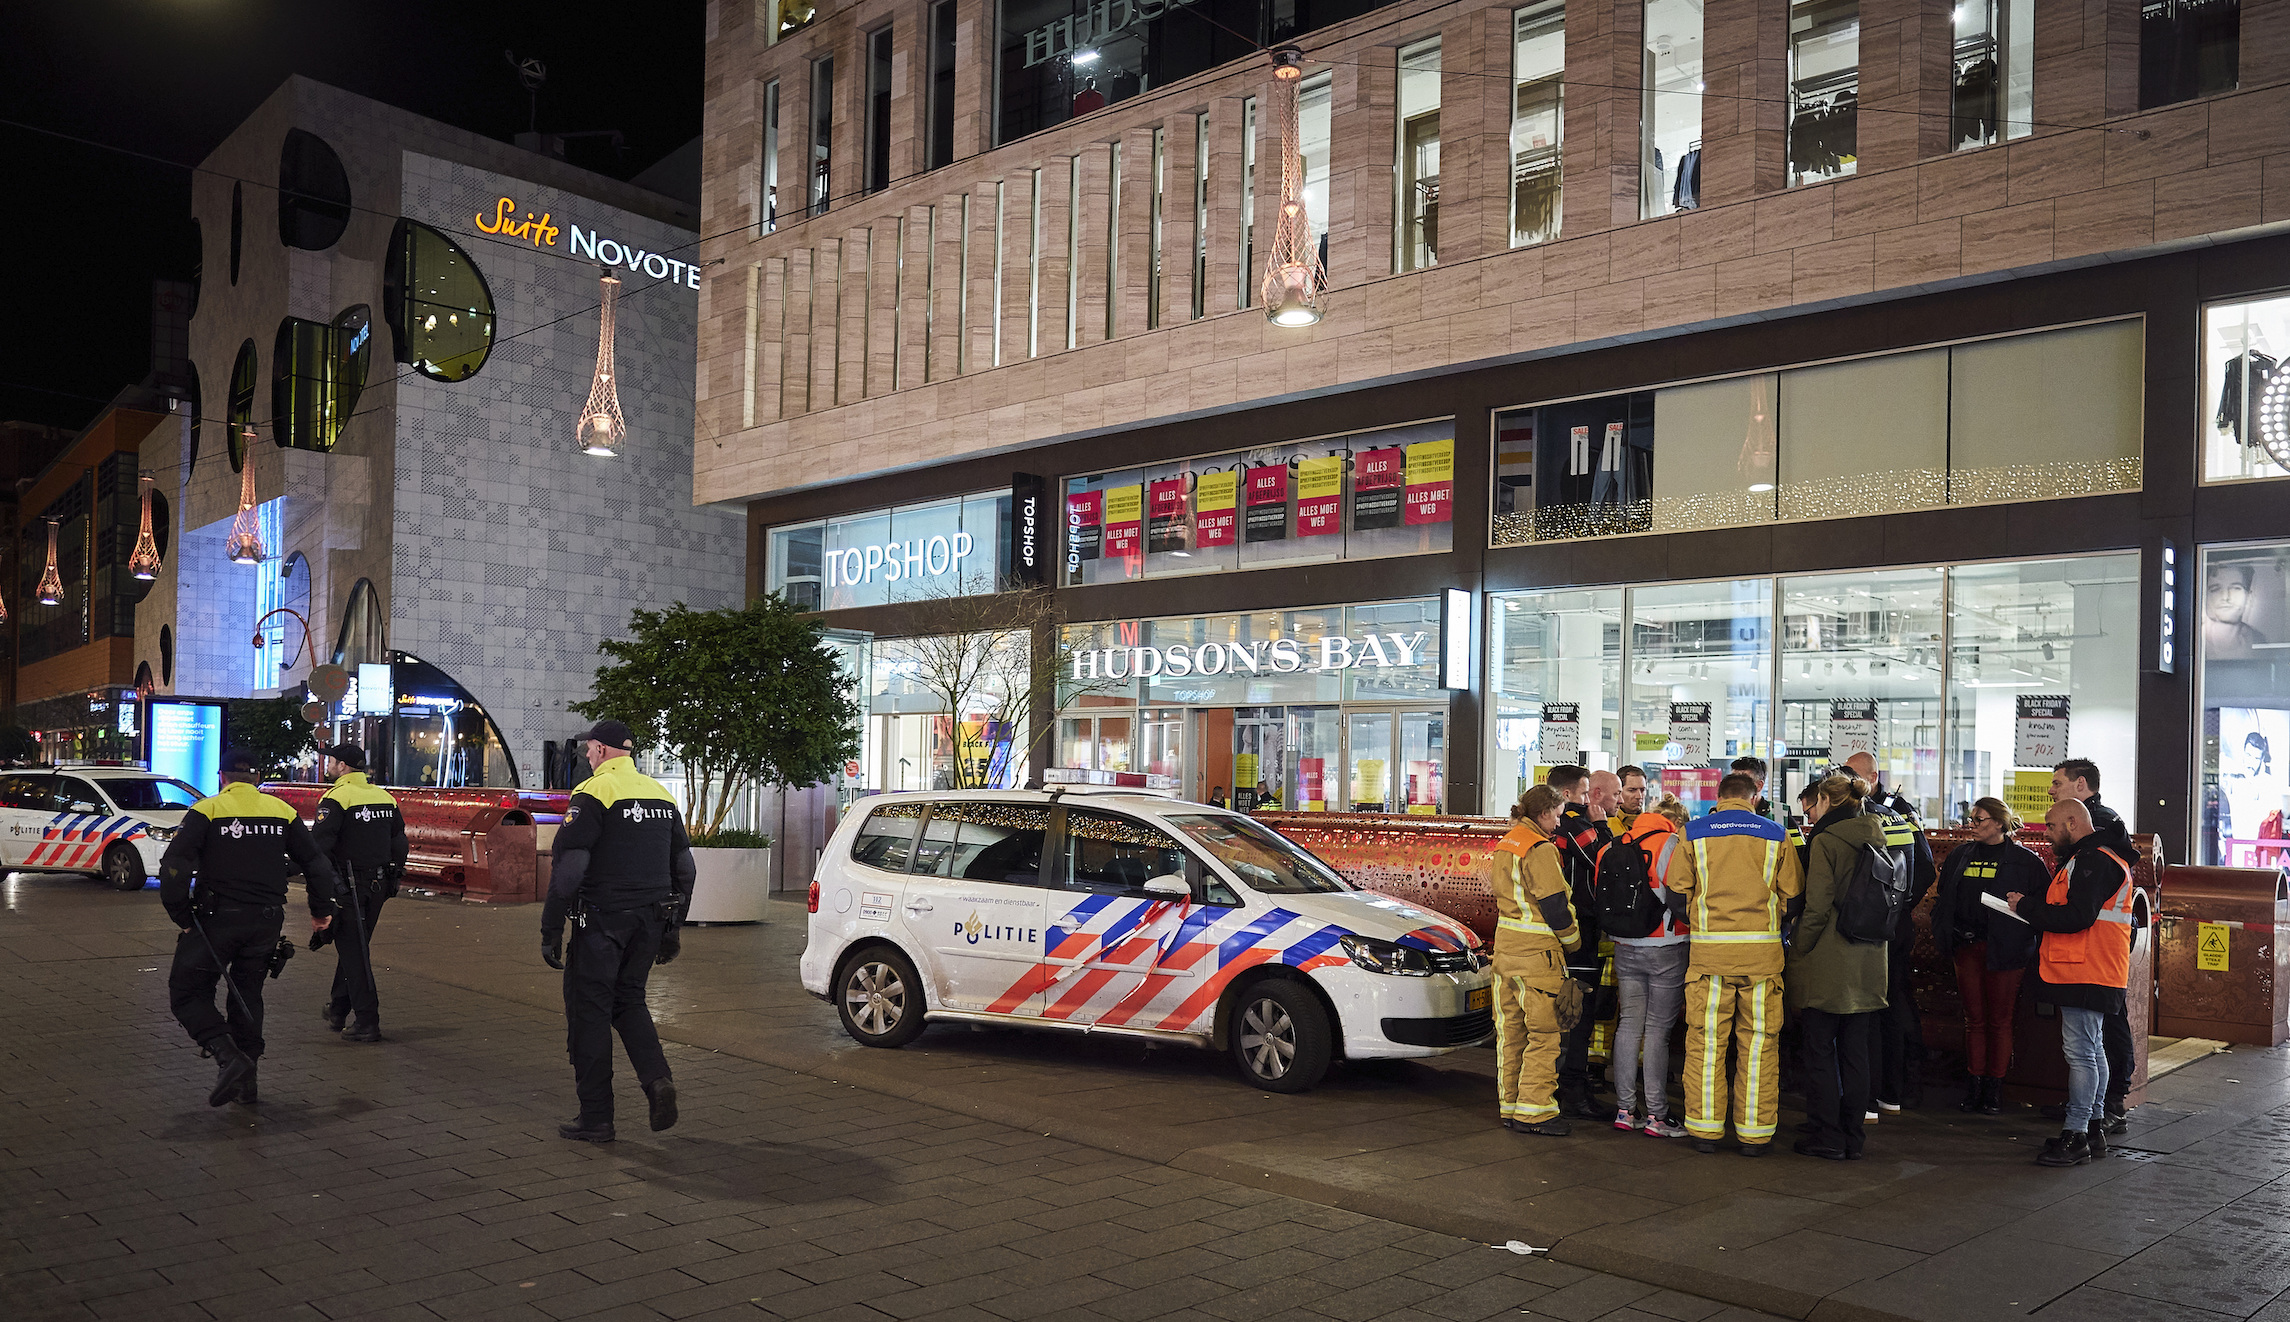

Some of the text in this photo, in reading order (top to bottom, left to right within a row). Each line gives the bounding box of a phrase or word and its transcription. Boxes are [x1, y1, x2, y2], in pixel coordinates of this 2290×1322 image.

[476, 197, 559, 247] Suite
[1366, 461, 1387, 473] ALLES
[1256, 477, 1275, 488] ALLES
[1159, 490, 1176, 502] ALLES
[1407, 489, 1450, 504] ALLES MOET
[1299, 503, 1337, 516] ALLES MOET
[1420, 503, 1436, 515] WEG
[1198, 516, 1233, 529] ALLES MOET
[1310, 516, 1325, 527] WEG
[1023, 497, 1035, 566] TOPSHOP
[1107, 529, 1122, 540] ALLES
[1123, 527, 1138, 538] MOET
[1208, 529, 1222, 538] WEG
[1116, 539, 1128, 549] WEG
[825, 532, 973, 588] TOPSHOP
[1071, 631, 1426, 680] HUDSON'S BAY
[1837, 702, 1870, 710] BLACK FRIDAY
[2024, 700, 2062, 708] BLACK FRIDAY
[2031, 709, 2053, 717] SPECIAL
[355, 808, 393, 822] POLITIE
[623, 806, 673, 823] POLITIE
[10, 825, 40, 836] POLITIE
[221, 823, 283, 839] POLITIE
[962, 896, 994, 904] waakzaam
[1003, 899, 1036, 907] dienstbaar
[954, 920, 1037, 945] POLITIE
